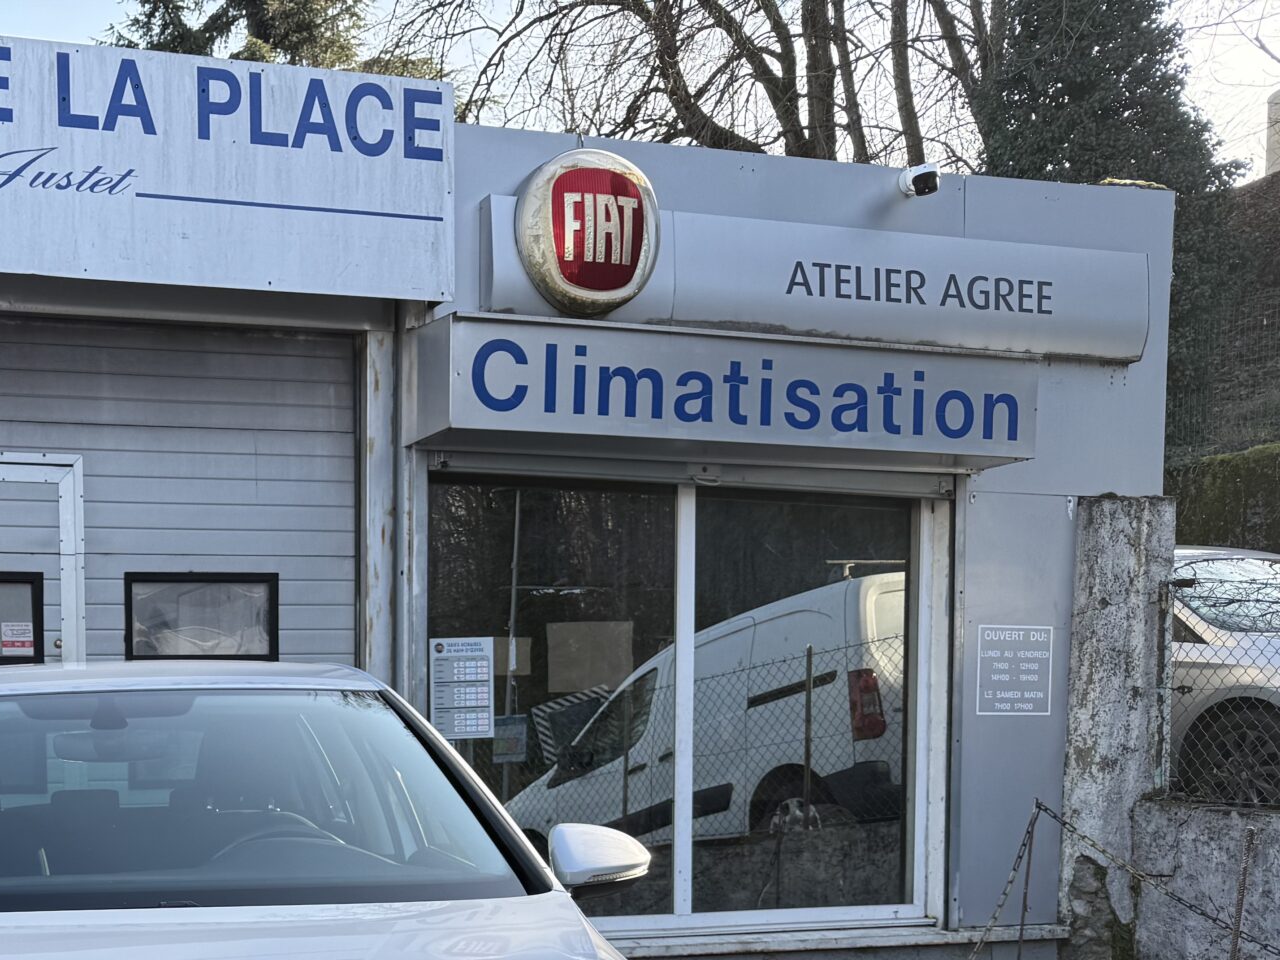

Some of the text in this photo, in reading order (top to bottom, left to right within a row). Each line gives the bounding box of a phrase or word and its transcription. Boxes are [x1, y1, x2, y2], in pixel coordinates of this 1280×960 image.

[56, 51, 157, 136] LA
[197, 65, 444, 162] PLACE
[563, 192, 639, 266] FIAT
[785, 260, 1054, 316] ATELIER AGREE
[470, 337, 1019, 442] Climatisation
[984, 630, 1025, 641] OUVERT
[980, 650, 1050, 658] LUNDI AU VENDREDI
[992, 662, 1009, 670] 7H00
[984, 690, 1044, 699] LE SAMEDI MATIN
[994, 702, 1011, 710] 7H00
